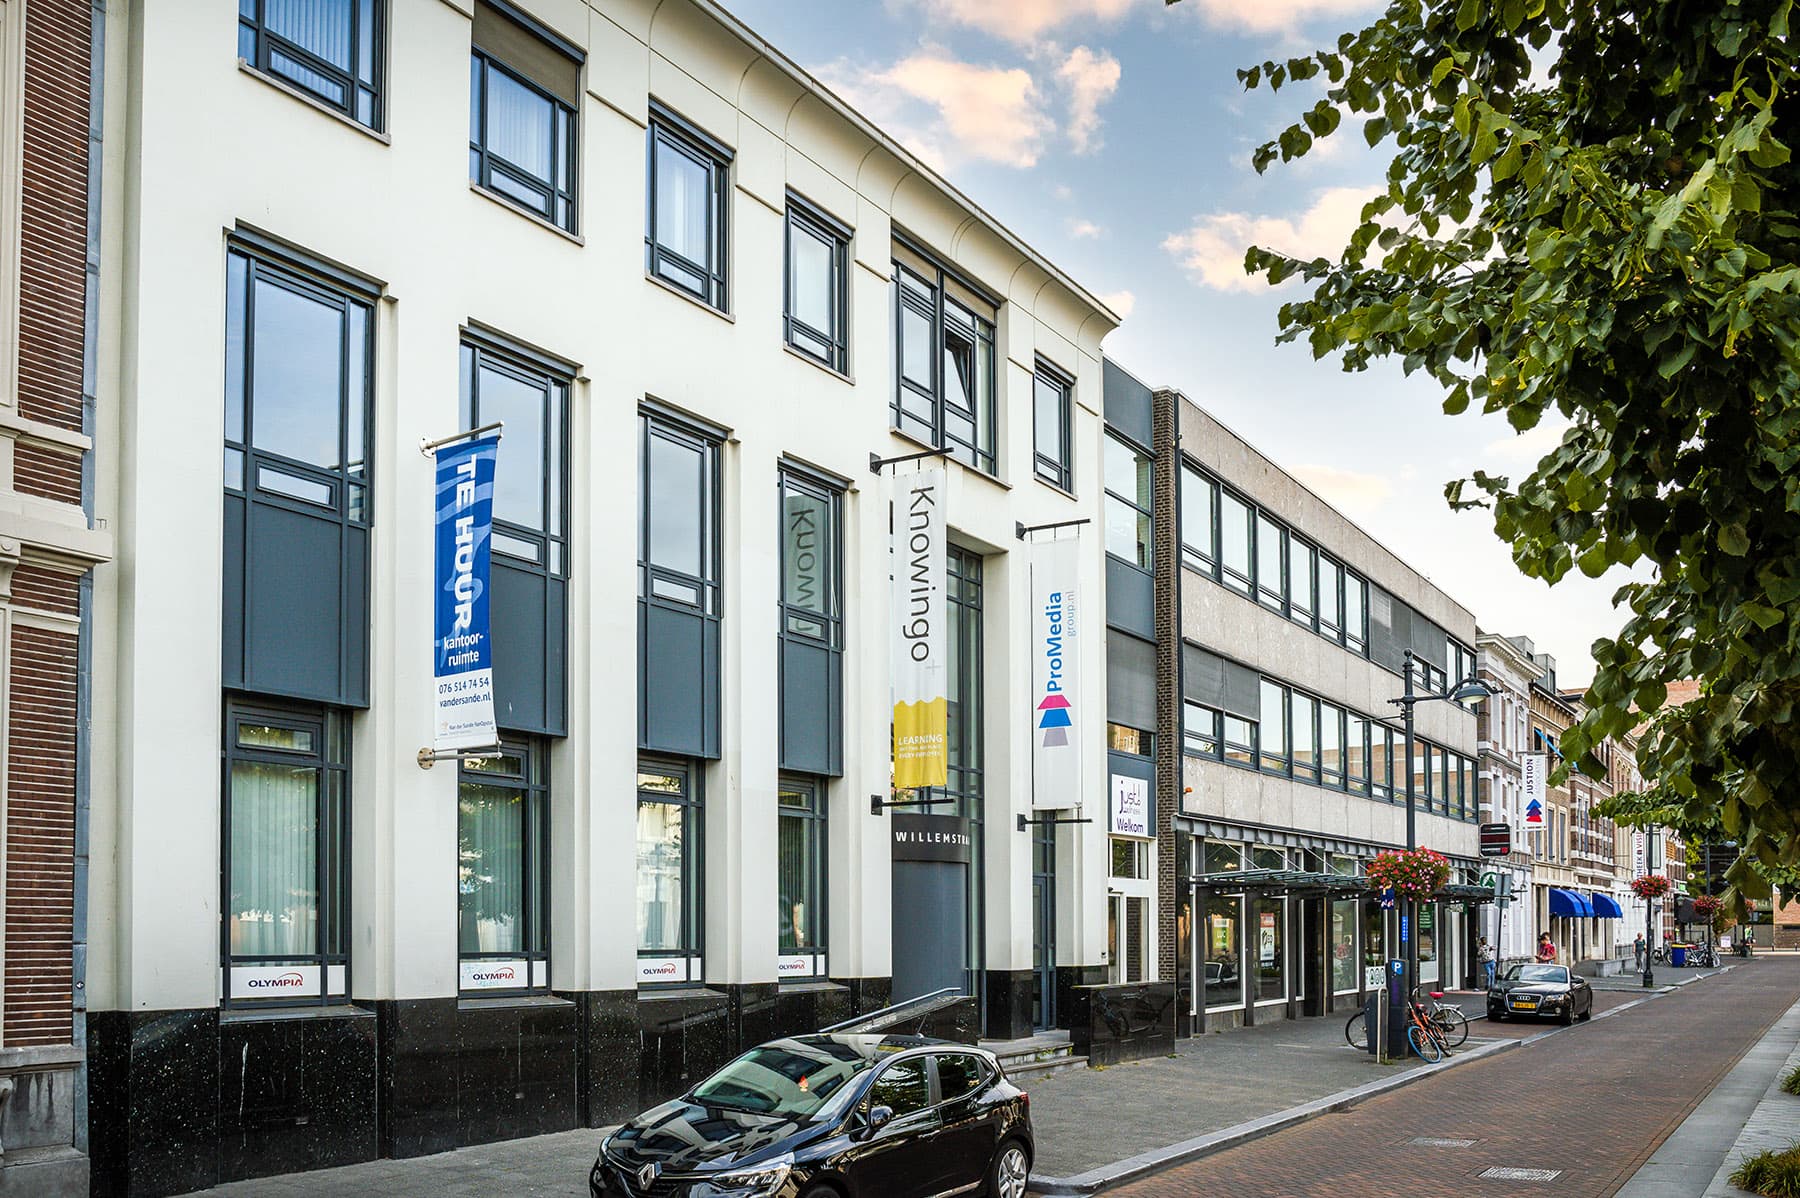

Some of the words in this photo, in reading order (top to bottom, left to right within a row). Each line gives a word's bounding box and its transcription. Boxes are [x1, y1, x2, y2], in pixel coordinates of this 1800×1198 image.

[456, 454, 476, 512] TE
[454, 516, 474, 632] HUUR
[1066, 591, 1076, 637] group.nl
[443, 632, 484, 650] kantoor-
[1045, 592, 1062, 692] ProMedia
[448, 650, 480, 667] ruimte
[439, 683, 453, 694] 076
[454, 681, 467, 692] 514
[469, 679, 477, 689] 74
[480, 677, 490, 687] 54
[439, 691, 492, 708] vandersande.nl
[898, 734, 943, 746] LEARNING
[1526, 758, 1534, 795] JUSTION
[1117, 817, 1144, 833] Welkom
[642, 966, 677, 975] OLYMPIA
[778, 962, 806, 970] OLYMPIA
[248, 976, 304, 988] OLYMPIA
[472, 970, 515, 981] OLYMPIA
